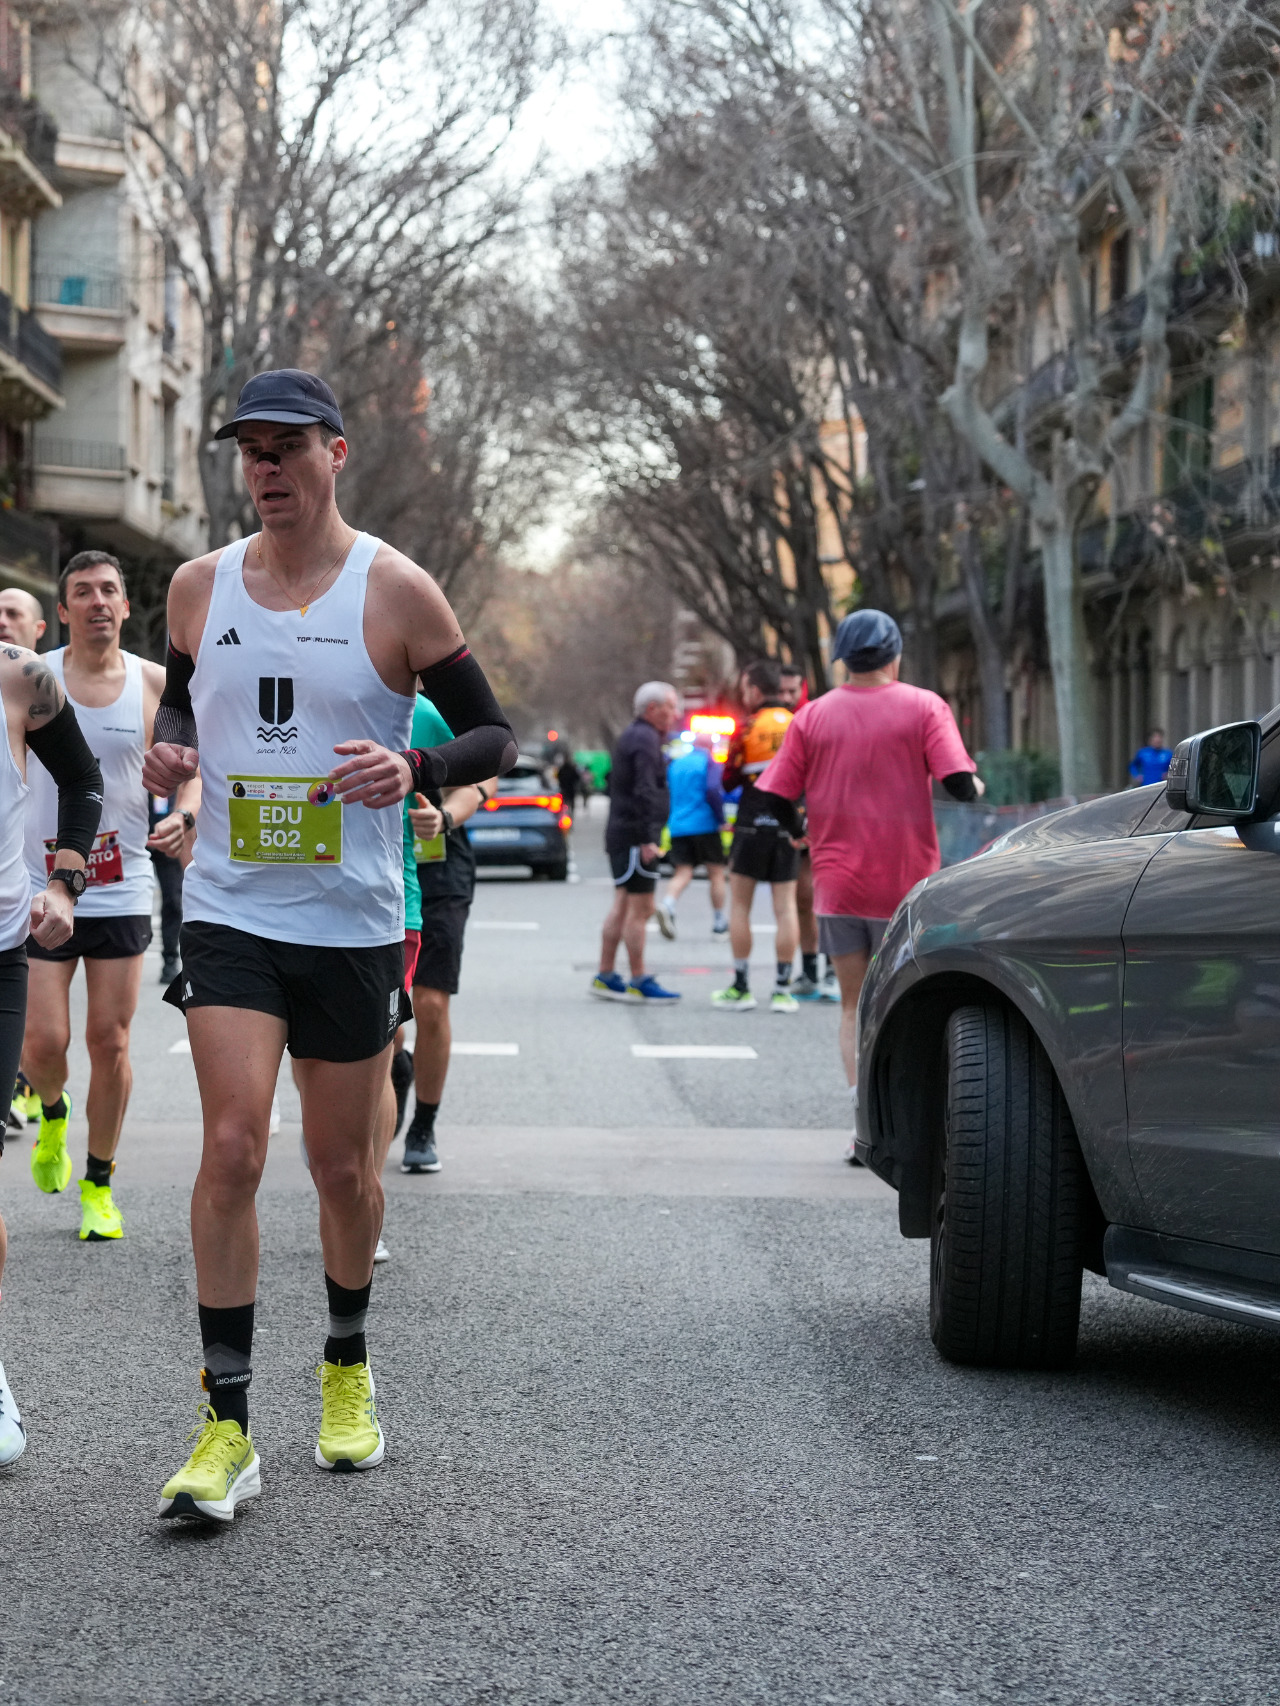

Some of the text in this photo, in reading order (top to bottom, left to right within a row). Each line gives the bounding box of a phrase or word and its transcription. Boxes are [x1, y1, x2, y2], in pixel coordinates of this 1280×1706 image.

[279, 745, 297, 755] 1926
[259, 805, 302, 824] EDU
[260, 829, 301, 848] 502
